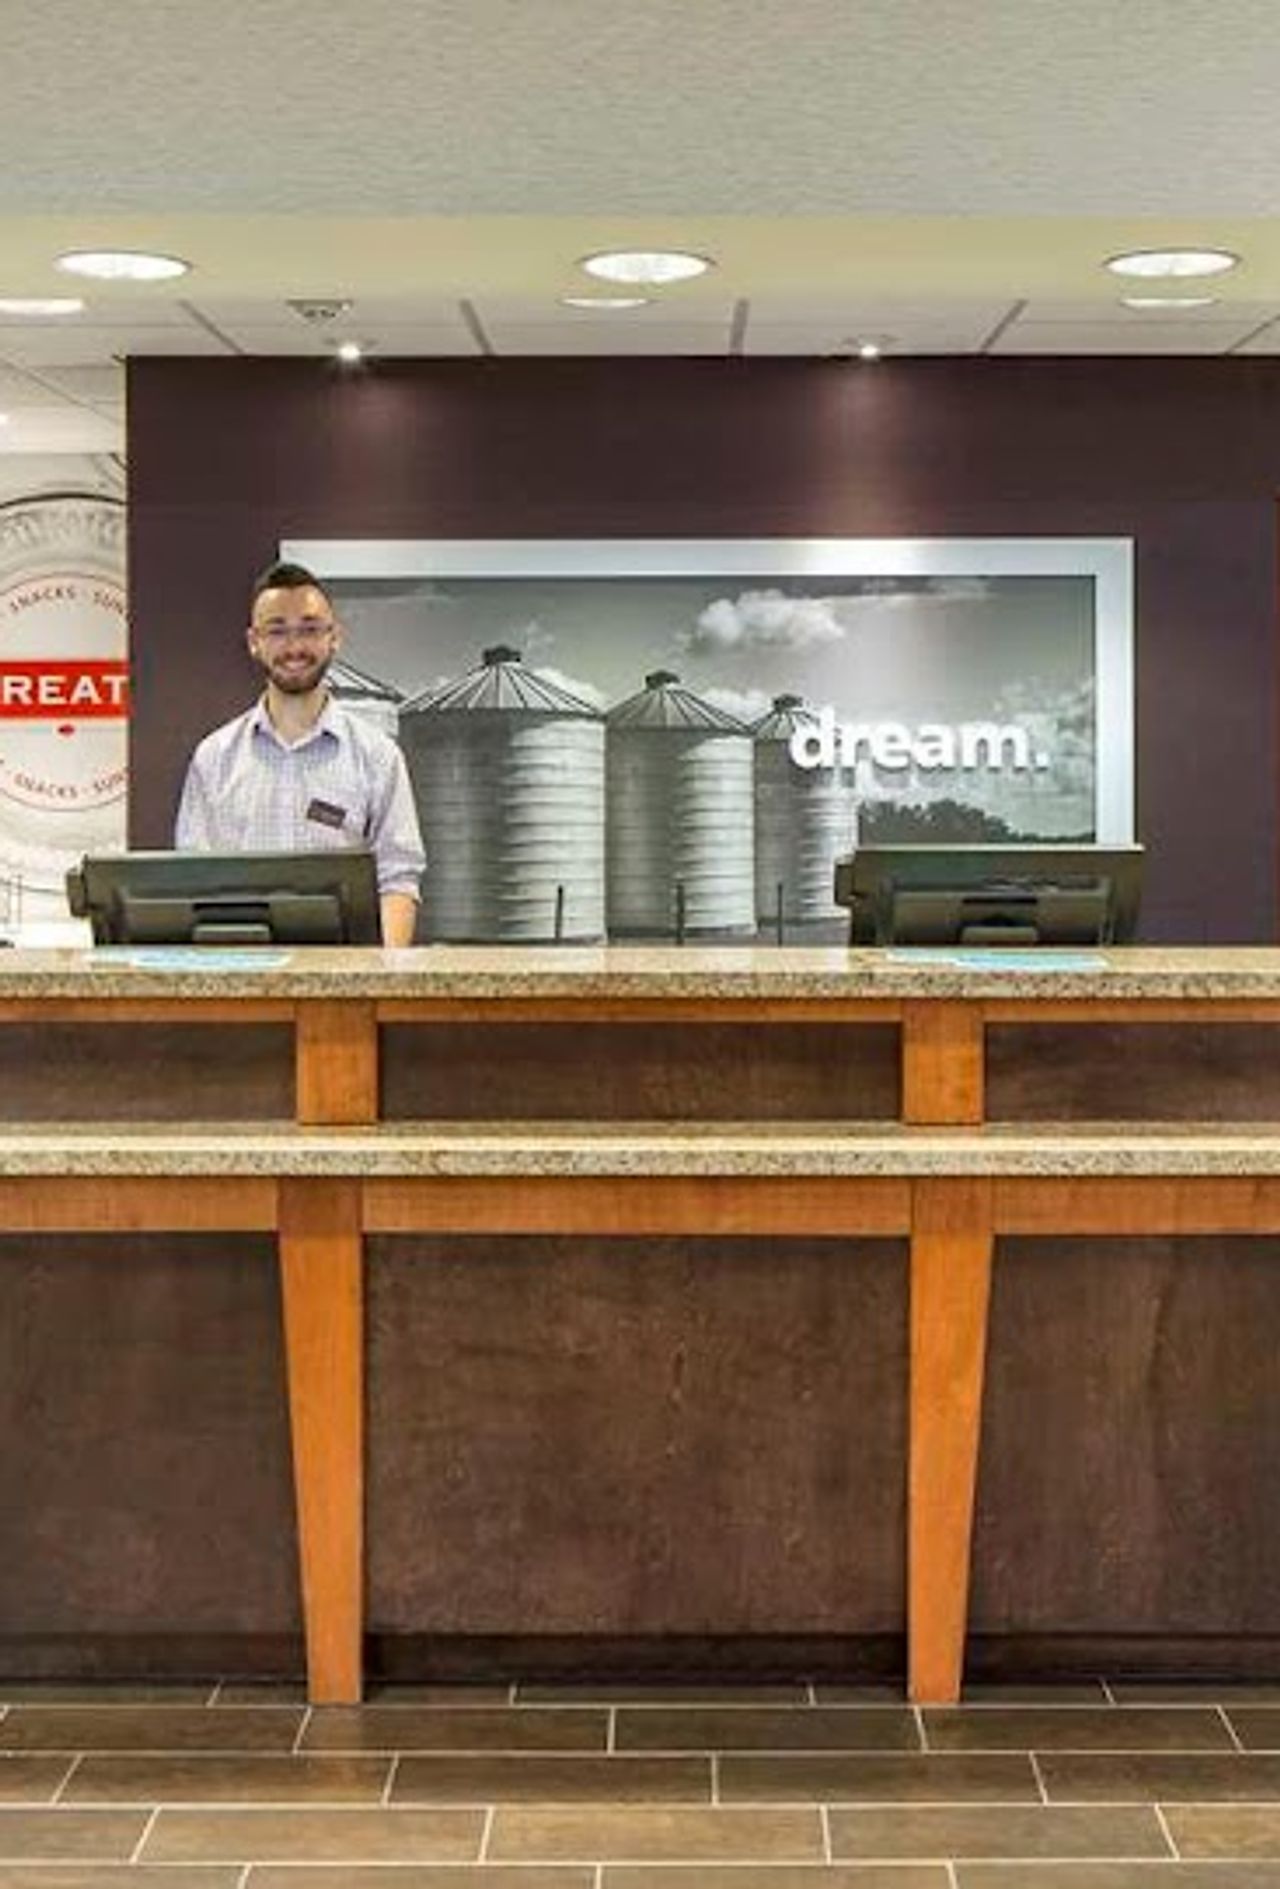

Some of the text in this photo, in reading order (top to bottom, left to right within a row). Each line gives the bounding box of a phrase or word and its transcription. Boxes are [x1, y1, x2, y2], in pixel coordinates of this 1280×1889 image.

[10, 585, 76, 612] SNACKS
[789, 706, 1047, 770] dream.
[14, 772, 78, 799] SNACKS
